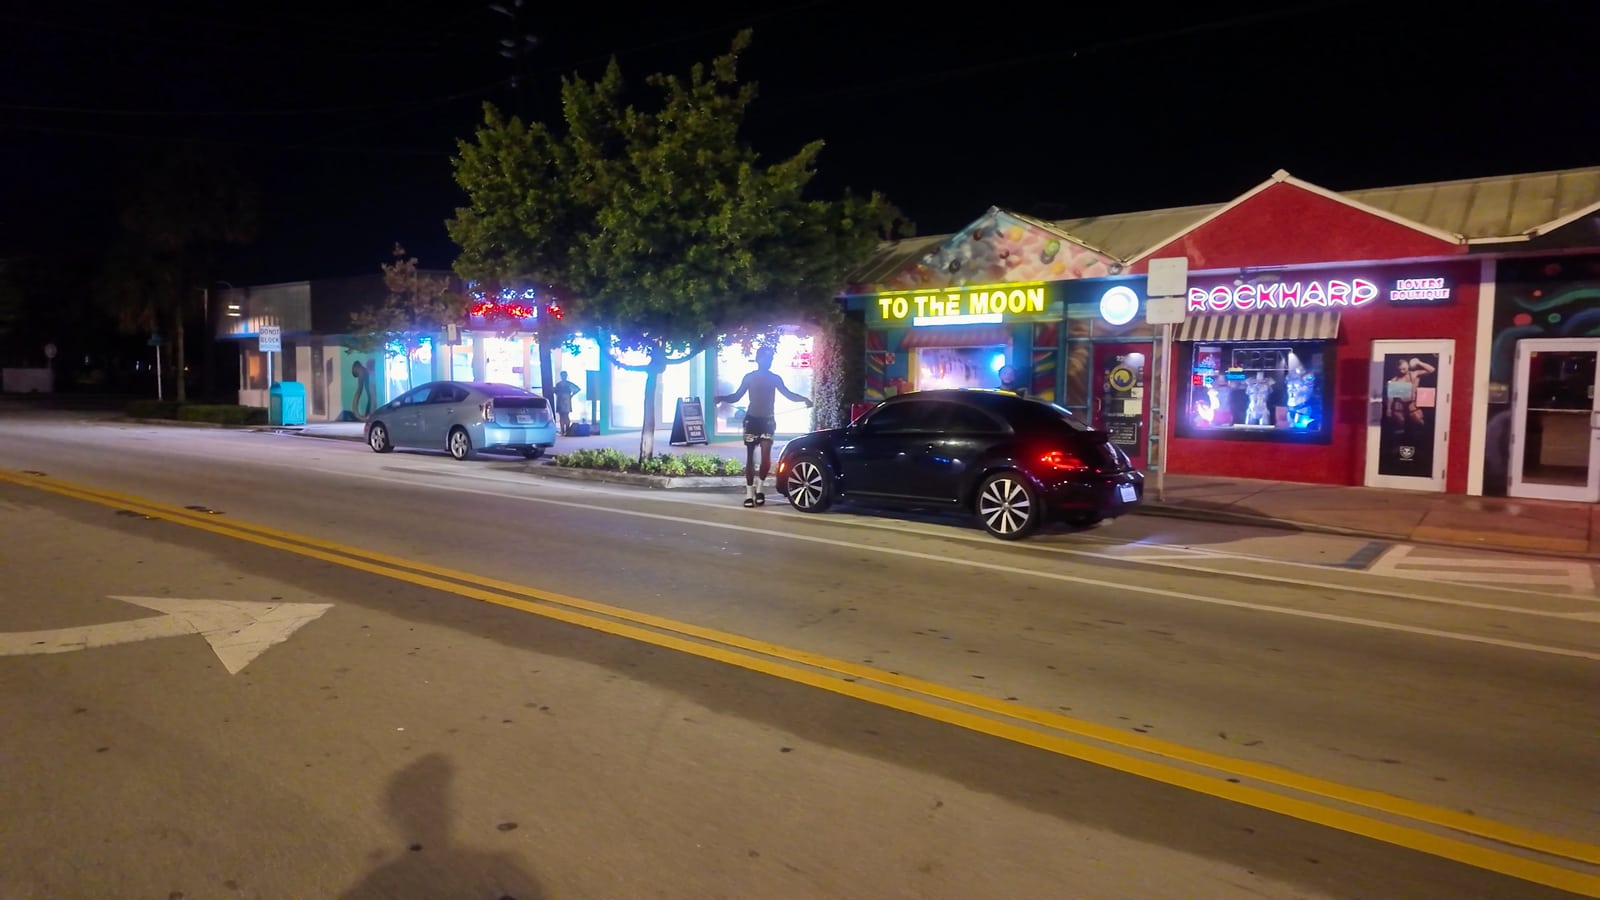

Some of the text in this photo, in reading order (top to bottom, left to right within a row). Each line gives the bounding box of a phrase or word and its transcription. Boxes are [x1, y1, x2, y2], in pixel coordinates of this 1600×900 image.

[1390, 288, 1450, 300] BOUTIQUE
[1397, 278, 1444, 290] LOVERS
[879, 297, 908, 319] TO
[969, 288, 1044, 314] MOON
[1188, 279, 1378, 311] ROCKHARD
